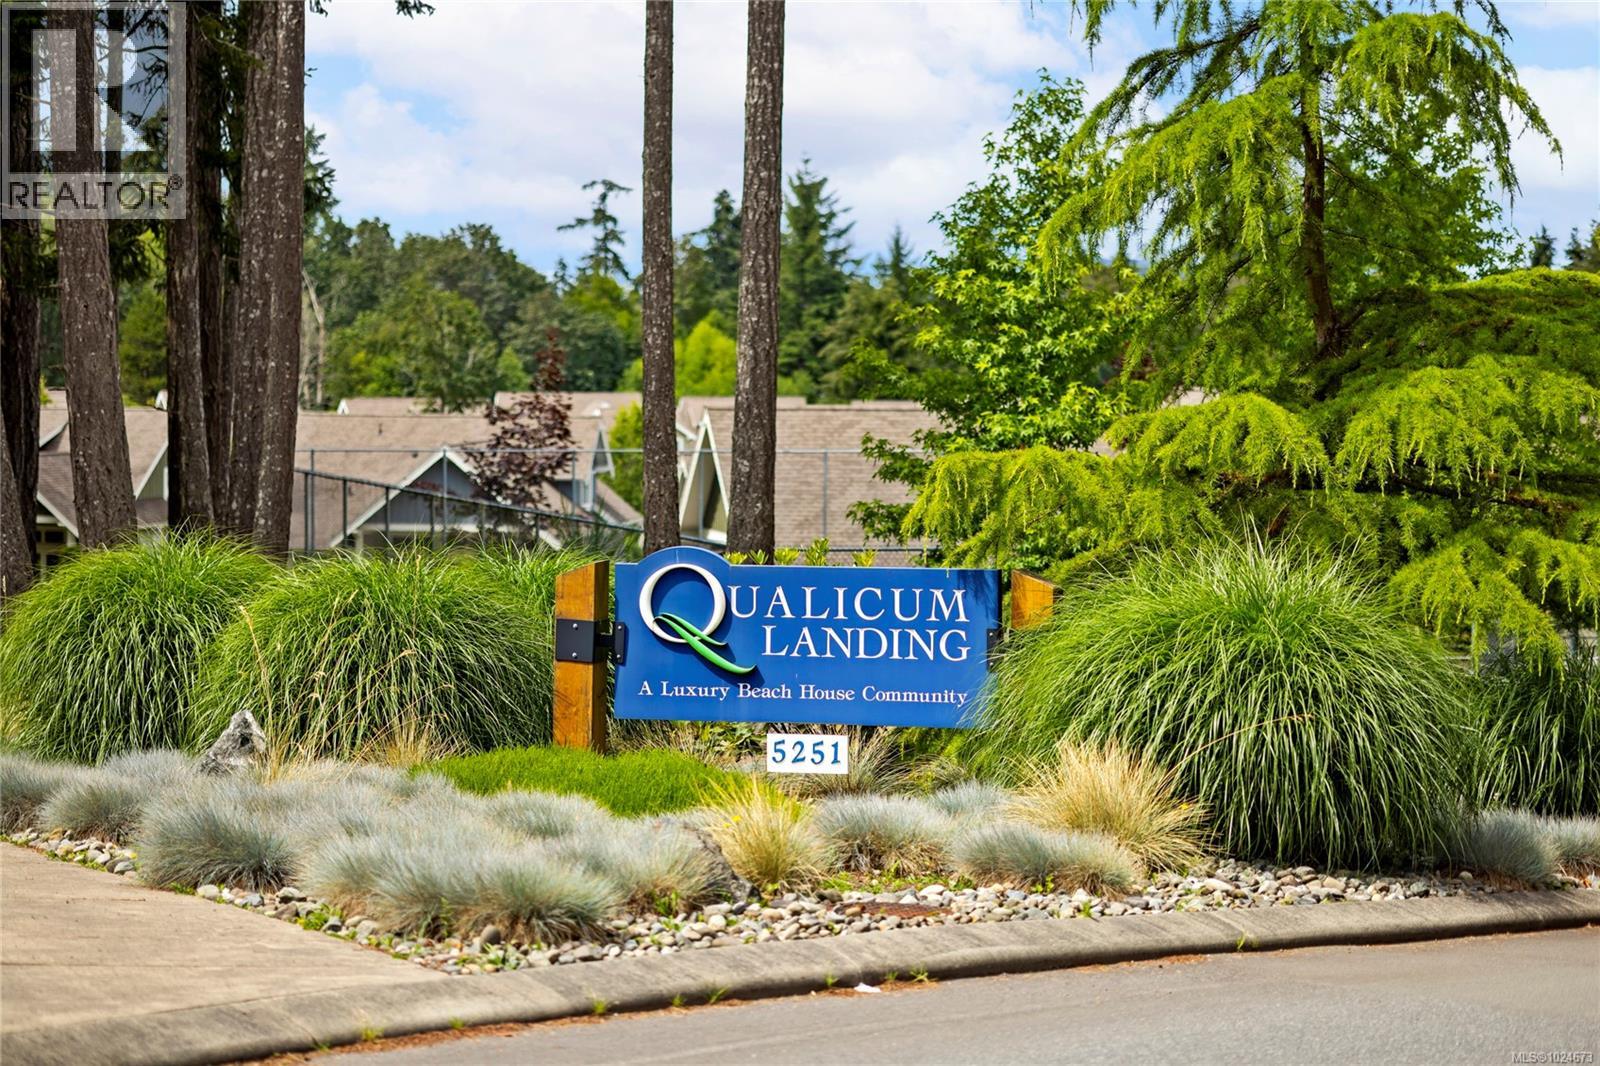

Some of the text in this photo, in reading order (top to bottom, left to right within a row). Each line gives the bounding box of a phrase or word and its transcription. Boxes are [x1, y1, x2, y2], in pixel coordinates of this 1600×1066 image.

[761, 625, 971, 662] LANDING
[638, 680, 968, 708] A Luxury Beach House Community
[771, 739, 841, 765] 5251
